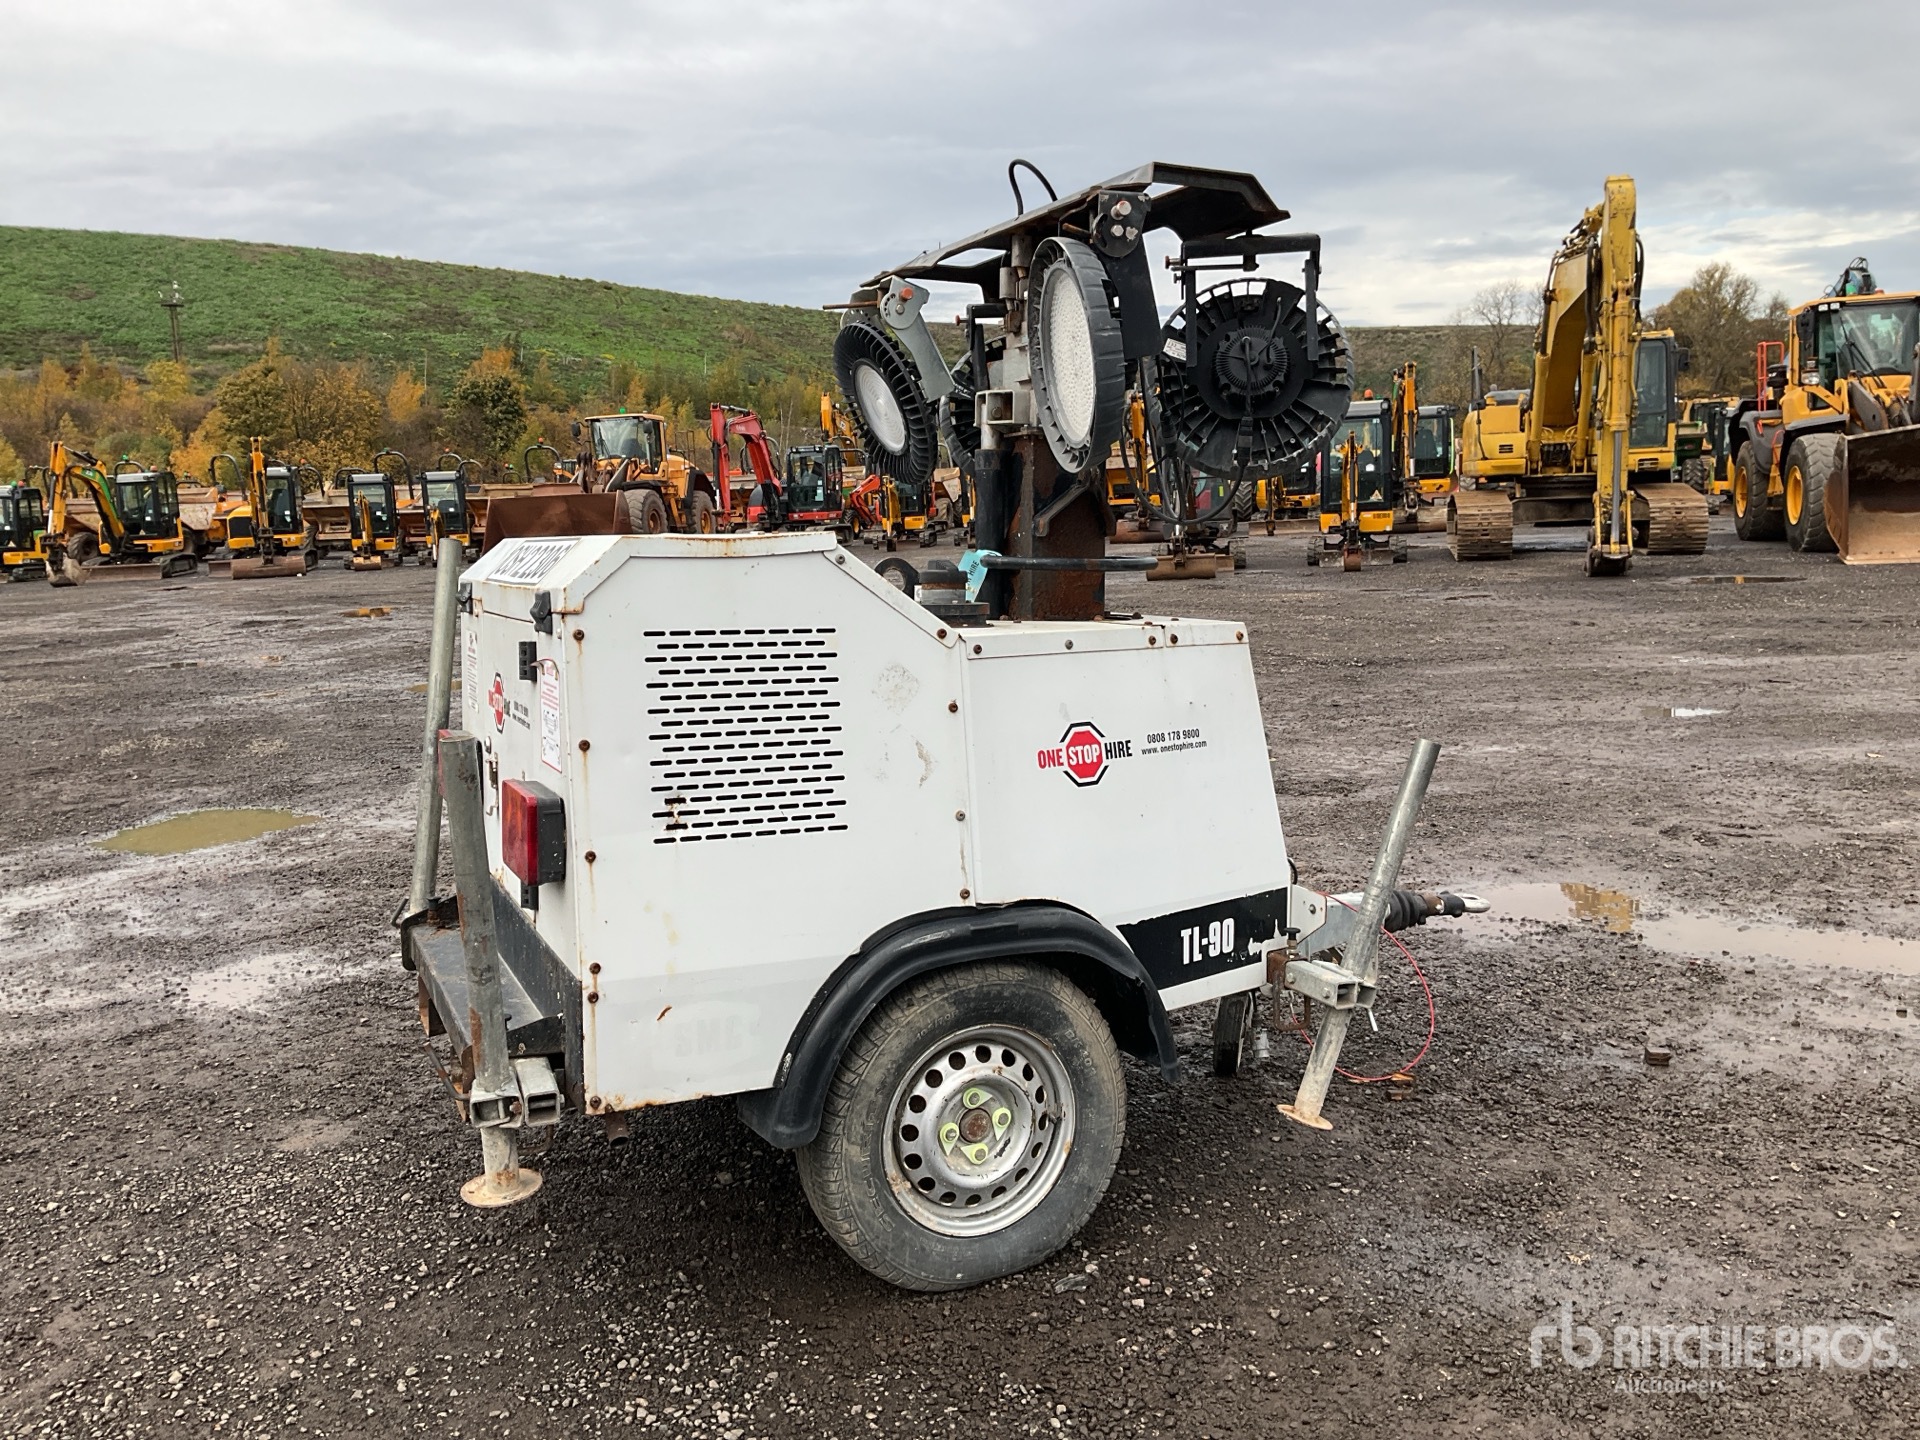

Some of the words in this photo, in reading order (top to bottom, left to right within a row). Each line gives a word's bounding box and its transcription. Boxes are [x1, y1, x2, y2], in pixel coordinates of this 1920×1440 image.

[1147, 732, 1166, 744] 0808
[1167, 730, 1181, 741] 178
[1182, 728, 1200, 740] 9800
[1037, 748, 1064, 769] ONE
[1068, 743, 1100, 766] STOP
[1104, 739, 1133, 760] HIRE
[1180, 917, 1235, 965] TL-90
